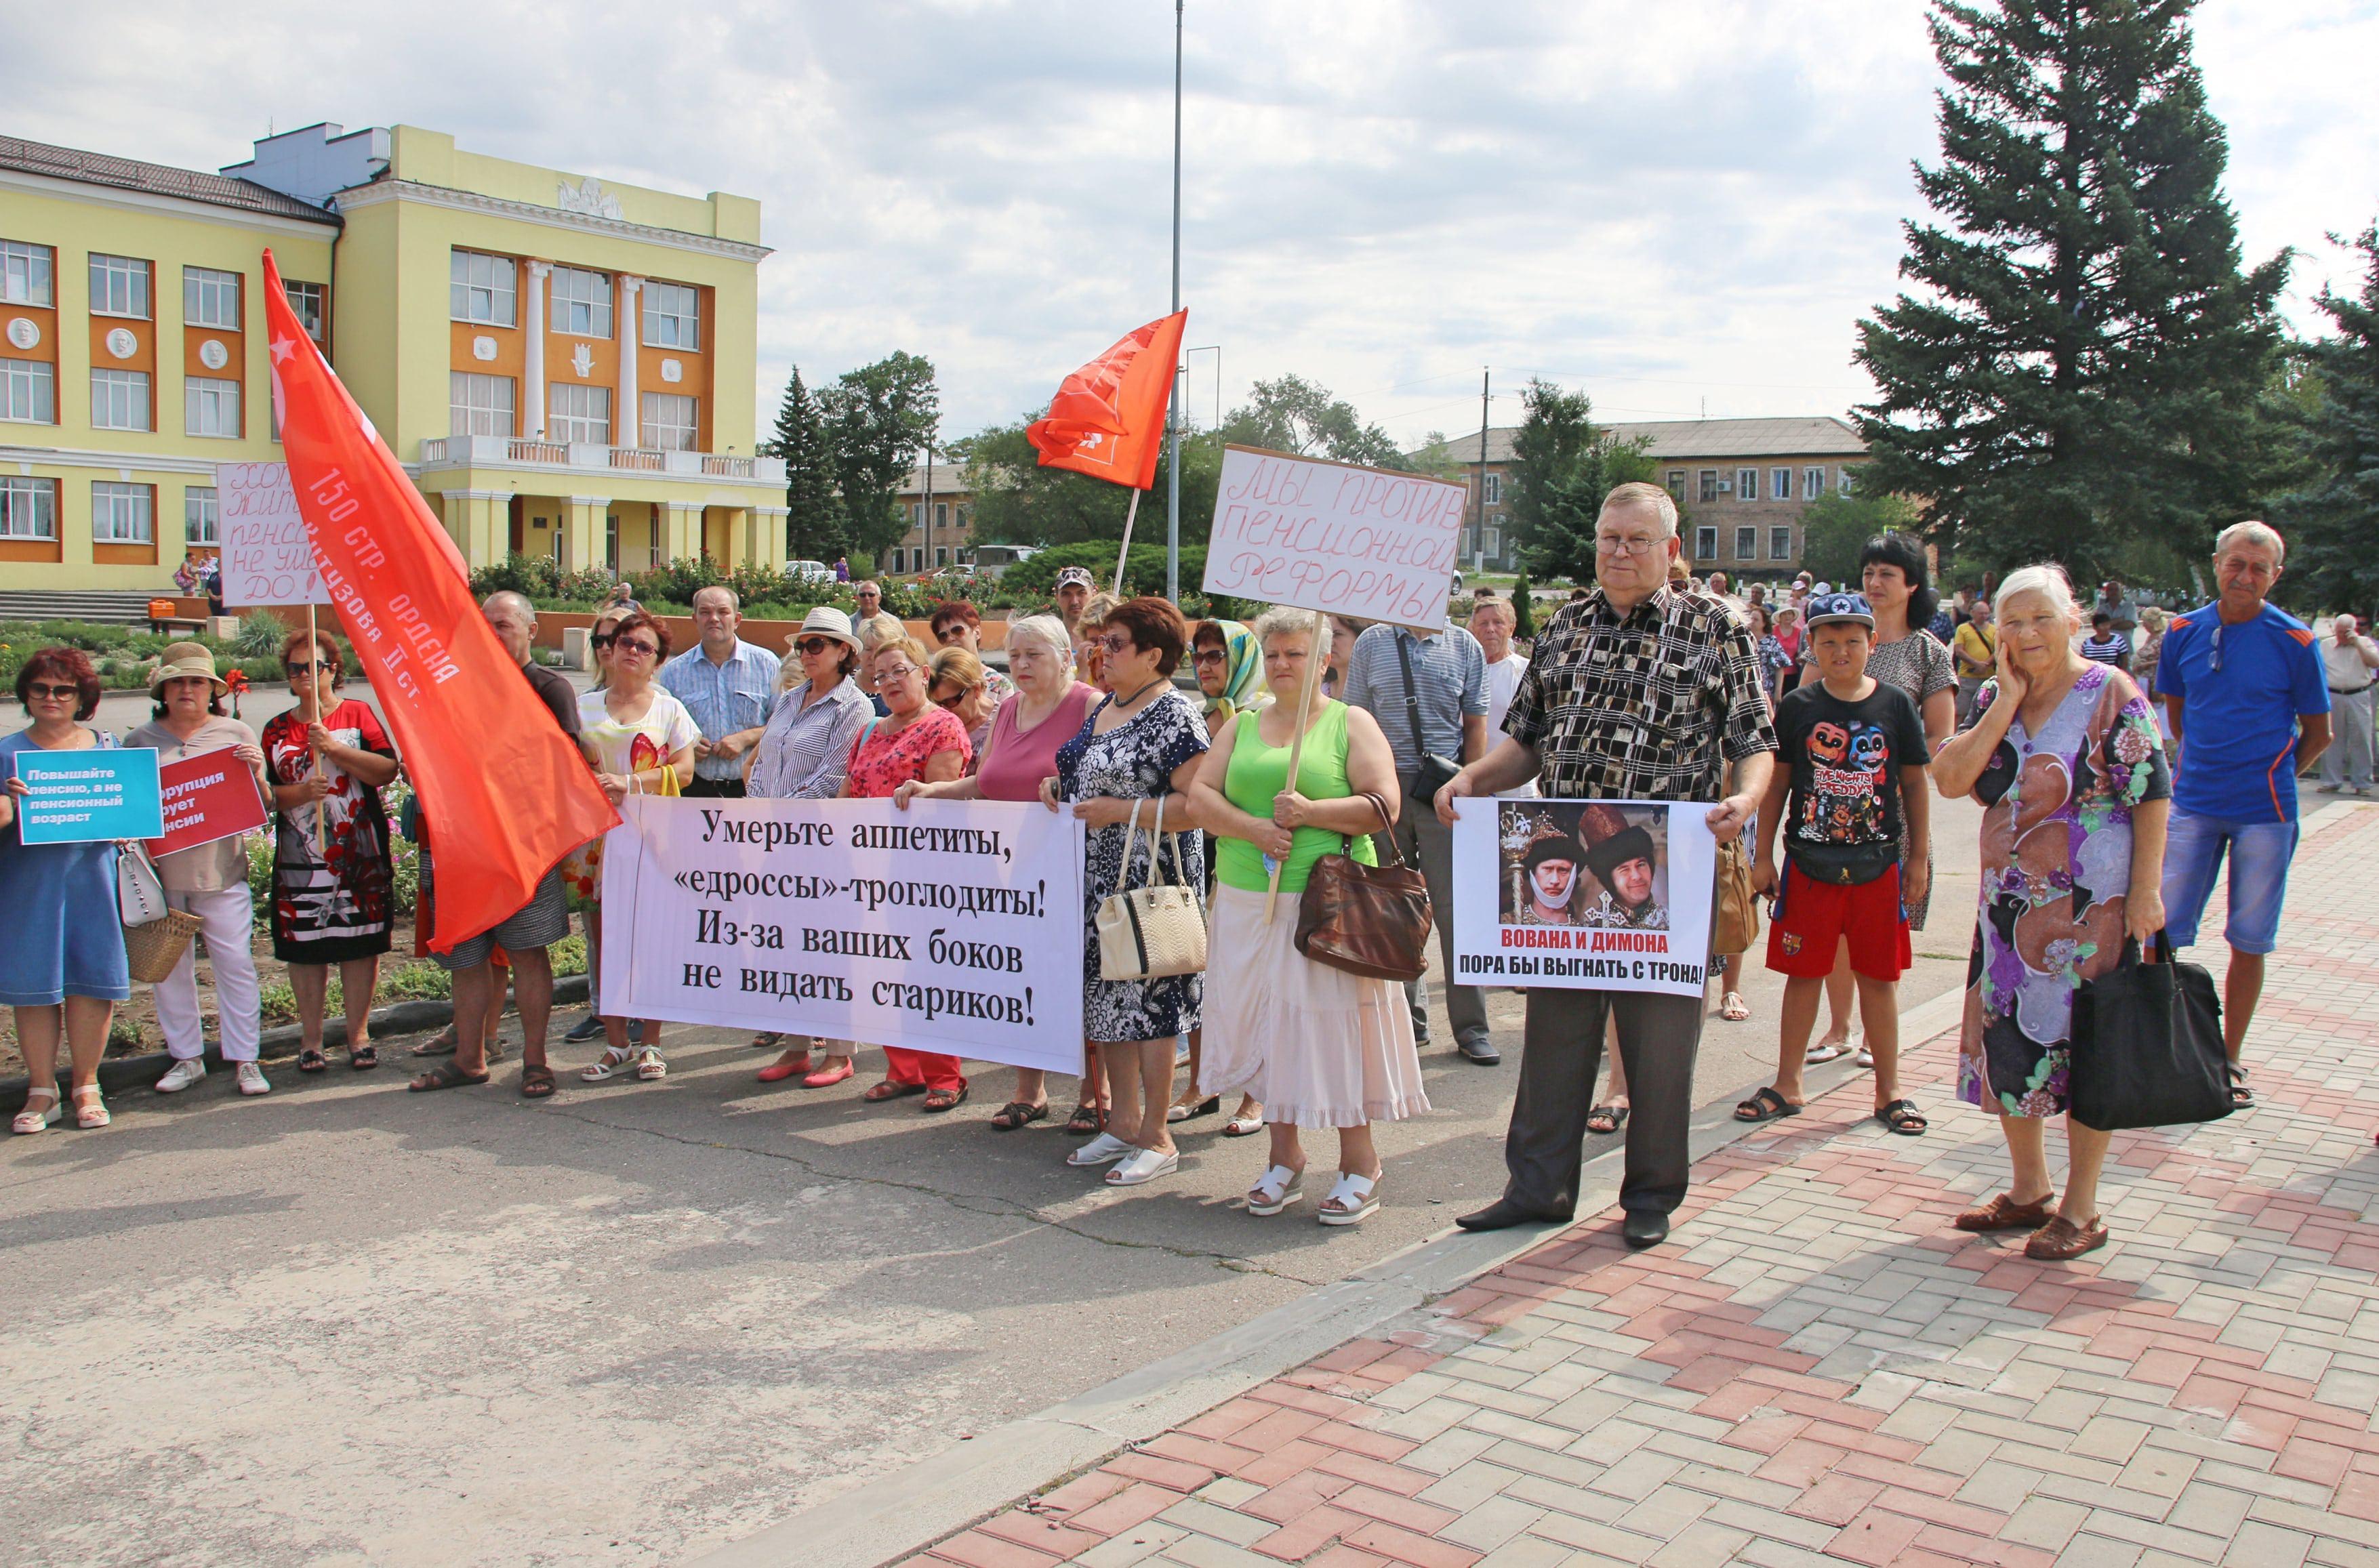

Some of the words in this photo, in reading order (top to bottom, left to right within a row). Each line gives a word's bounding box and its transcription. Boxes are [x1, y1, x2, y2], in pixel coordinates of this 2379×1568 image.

[1227, 458, 1312, 507] МЫ
[1333, 473, 1465, 530] ПРОТИВ
[309, 468, 359, 522] 150
[388, 594, 460, 684] ОРДЕНА
[1215, 552, 1445, 621] РЕФОРМЫ
[28, 767, 115, 781] Повышайте
[30, 785, 91, 794] пенсию,
[94, 784, 102, 793] а
[104, 783, 123, 792] не
[30, 795, 123, 809] пенсионный
[31, 813, 92, 825] возраст
[701, 810, 833, 852] Умерьте
[851, 824, 1011, 863] аппетиты,
[674, 869, 1045, 917] «едроссы»-троглодиты!
[695, 909, 784, 949] Из-за
[802, 928, 912, 960] ваших
[929, 928, 1022, 972] боков
[1501, 929, 1571, 949] ВОВАНА
[1576, 932, 1587, 949] И
[1591, 932, 1669, 953] ДИМОНА
[1460, 955, 1505, 974] ПОРА
[1509, 956, 1539, 975] БЫ
[1544, 957, 1627, 978] ВЫГНАТЬ
[1632, 960, 1644, 979] С
[1648, 962, 1703, 985] ТРОНА!
[683, 964, 722, 988] не
[740, 969, 853, 1004] видать
[872, 981, 1034, 1026] стариков!
